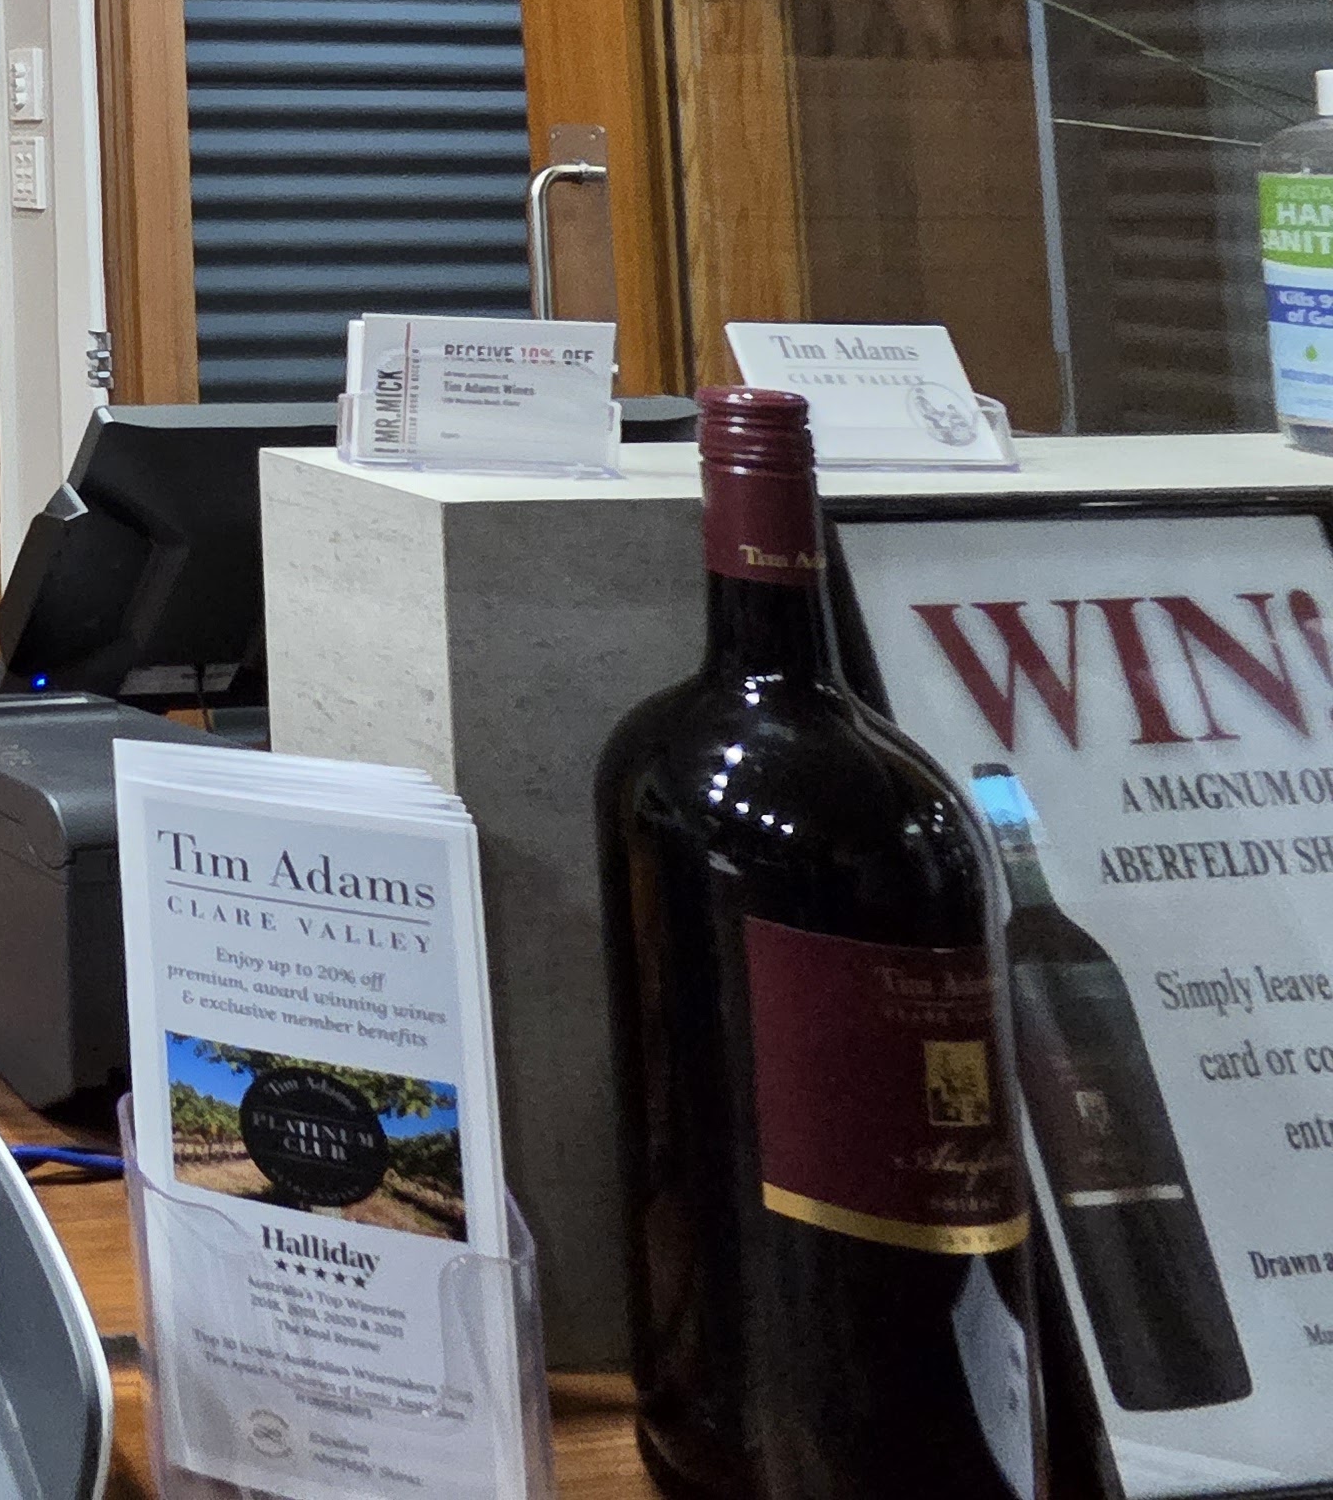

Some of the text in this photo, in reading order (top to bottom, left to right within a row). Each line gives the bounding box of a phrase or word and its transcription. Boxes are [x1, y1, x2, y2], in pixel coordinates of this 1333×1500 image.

[444, 343, 515, 363] RECEIVE
[769, 335, 920, 361] Tim Adams
[788, 373, 926, 386] CLARE VALLEY
[1120, 777, 1143, 814] A
[1140, 769, 1300, 813] MAGNUM
[157, 829, 436, 910] Tim Adams
[1099, 838, 1289, 885] ABERFELDY
[166, 894, 433, 954] CLARE VALLEY
[216, 946, 386, 992] Enjoy up to 20% off
[1154, 964, 1333, 1018] Simply leave
[199, 996, 277, 1021] exclusive
[281, 1011, 354, 1034] member
[357, 1020, 428, 1048] benefits
[252, 982, 309, 1002] award
[313, 991, 388, 1020] winning
[392, 1003, 447, 1024] wines
[1199, 1038, 1263, 1081] card
[1265, 1048, 1298, 1076] or
[253, 1111, 374, 1148] PLATINUM
[261, 1223, 381, 1278] Halliday
[1247, 1250, 1322, 1279] Drawn
